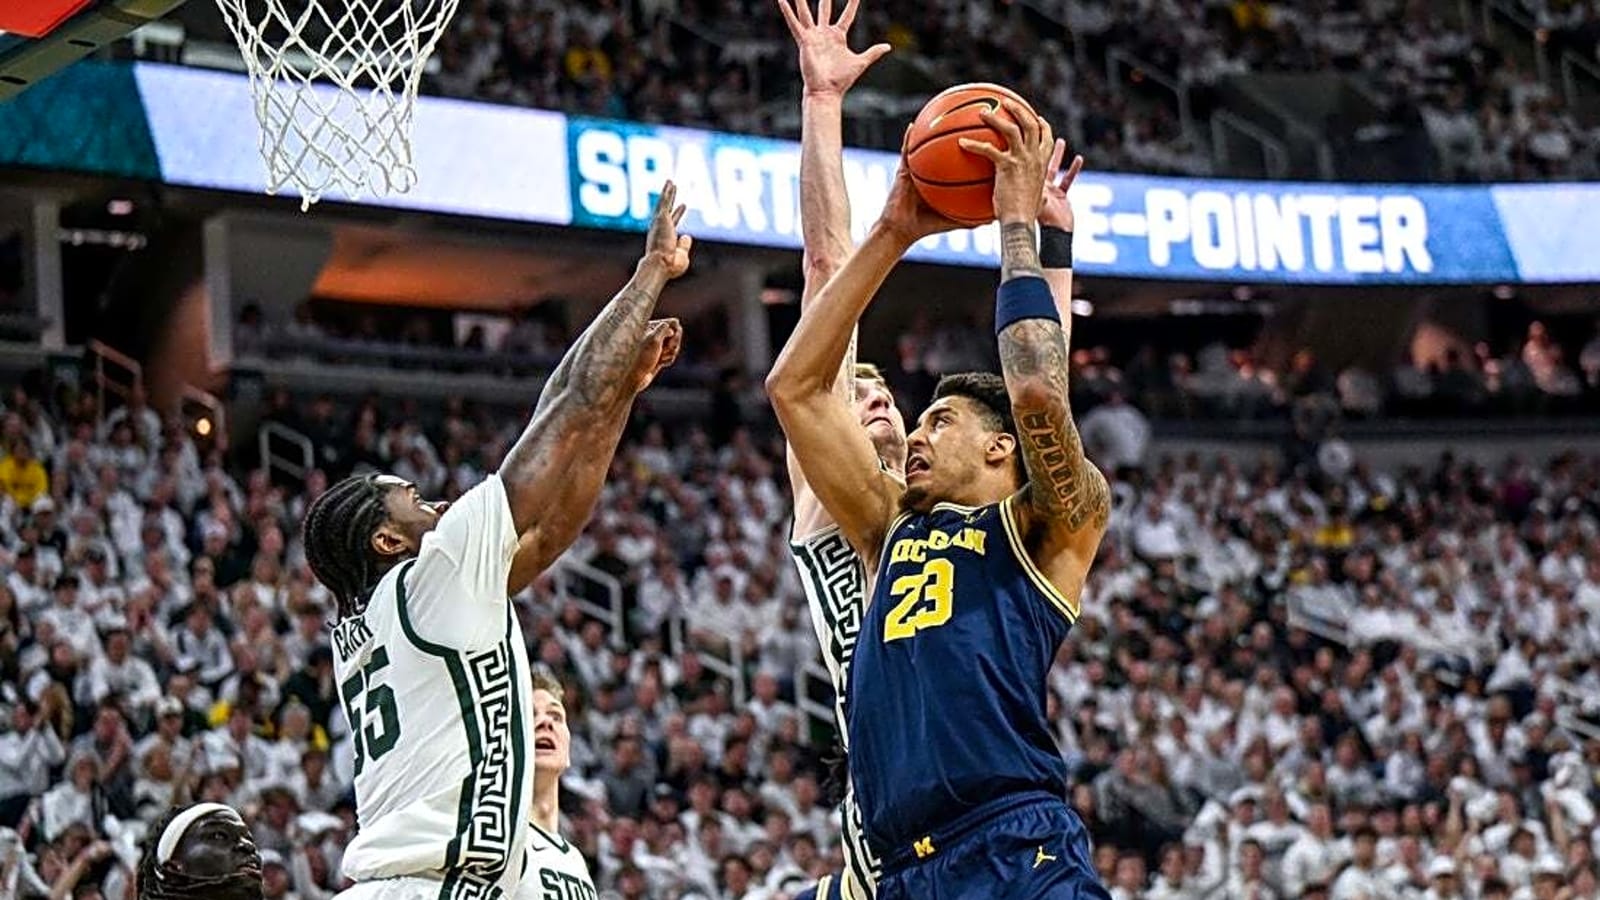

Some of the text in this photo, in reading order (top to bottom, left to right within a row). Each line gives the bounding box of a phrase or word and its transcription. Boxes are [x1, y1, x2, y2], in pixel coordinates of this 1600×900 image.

[576, 130, 893, 243] SPARTN
[884, 558, 954, 642] 23
[342, 644, 402, 777] 55
[913, 836, 936, 859] M
